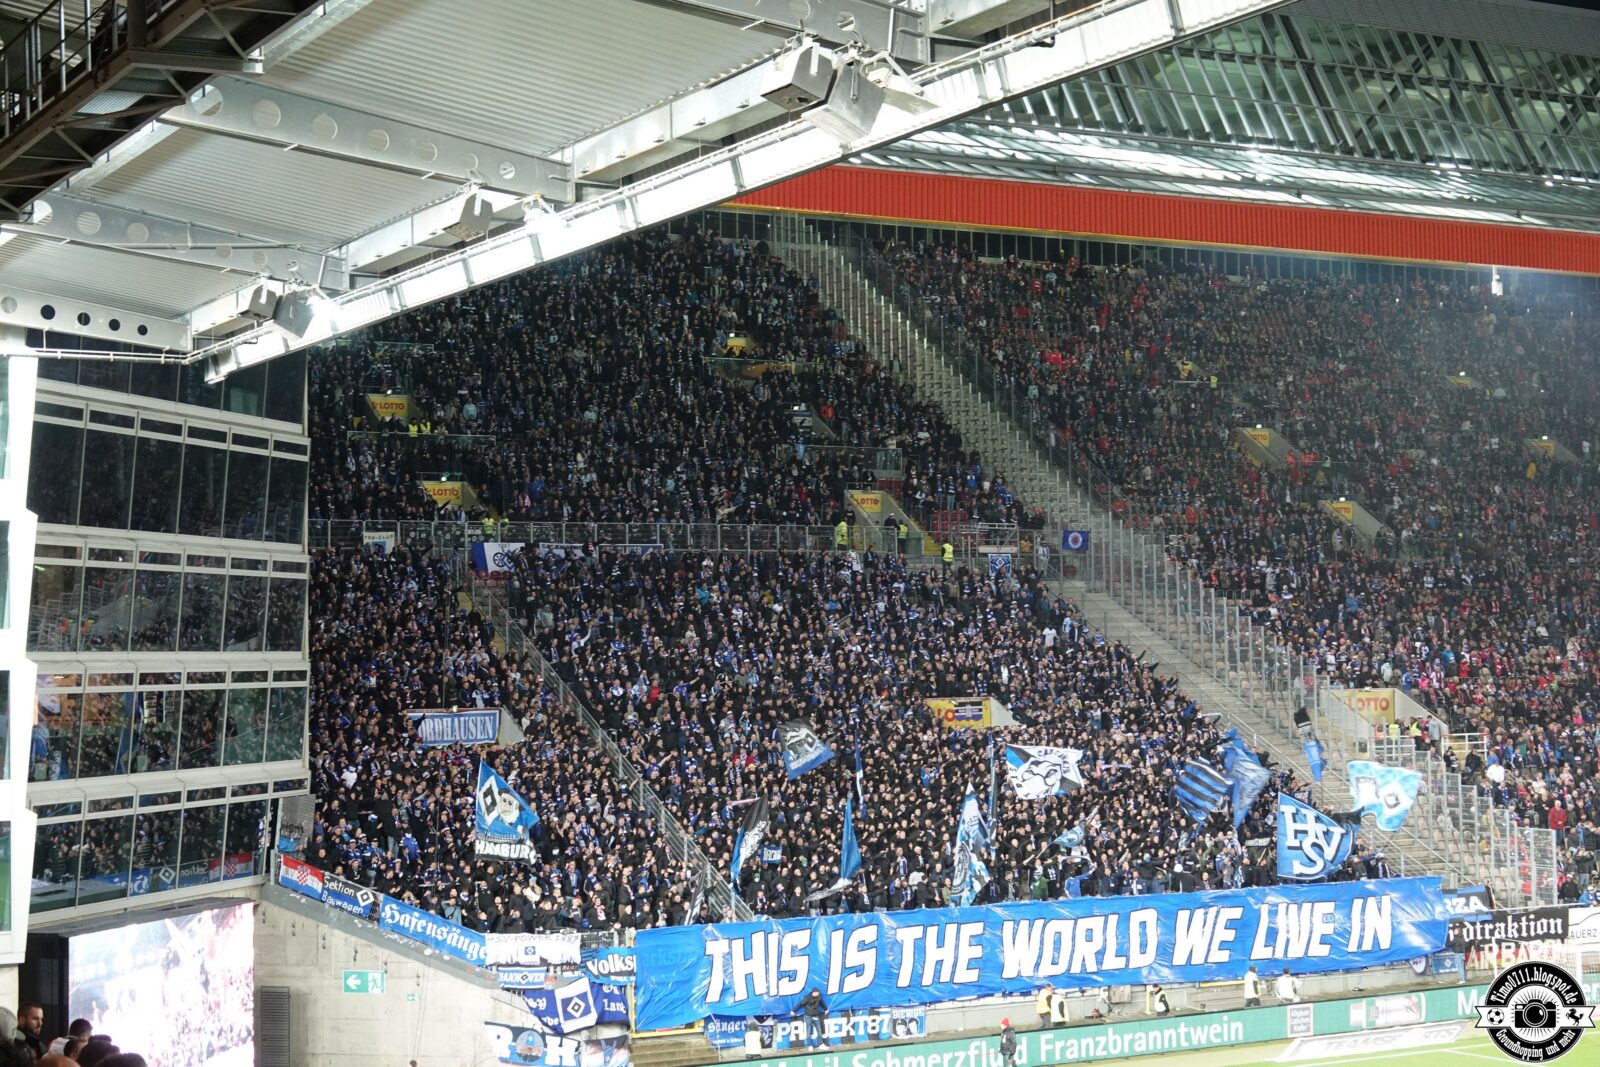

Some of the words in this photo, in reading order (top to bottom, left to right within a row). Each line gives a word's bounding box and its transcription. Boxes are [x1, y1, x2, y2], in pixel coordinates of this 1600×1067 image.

[379, 401, 405, 410] LOTTO
[432, 487, 460, 497] LOTTO
[1346, 696, 1390, 712] LOTTO
[417, 715, 494, 741] ORDHAUSEN
[324, 875, 355, 897] Sektion
[321, 890, 364, 915] Bauwagen
[705, 928, 811, 1004] THIS
[826, 924, 878, 996] IS
[895, 920, 985, 989] THE
[1001, 907, 1158, 979] WORLD
[1172, 905, 1244, 966] WE
[1250, 900, 1336, 960] LIVE
[1347, 894, 1392, 952] IN
[851, 1036, 1028, 1067] Schmerzflud
[1040, 1016, 1244, 1063] Franzbranntwein
